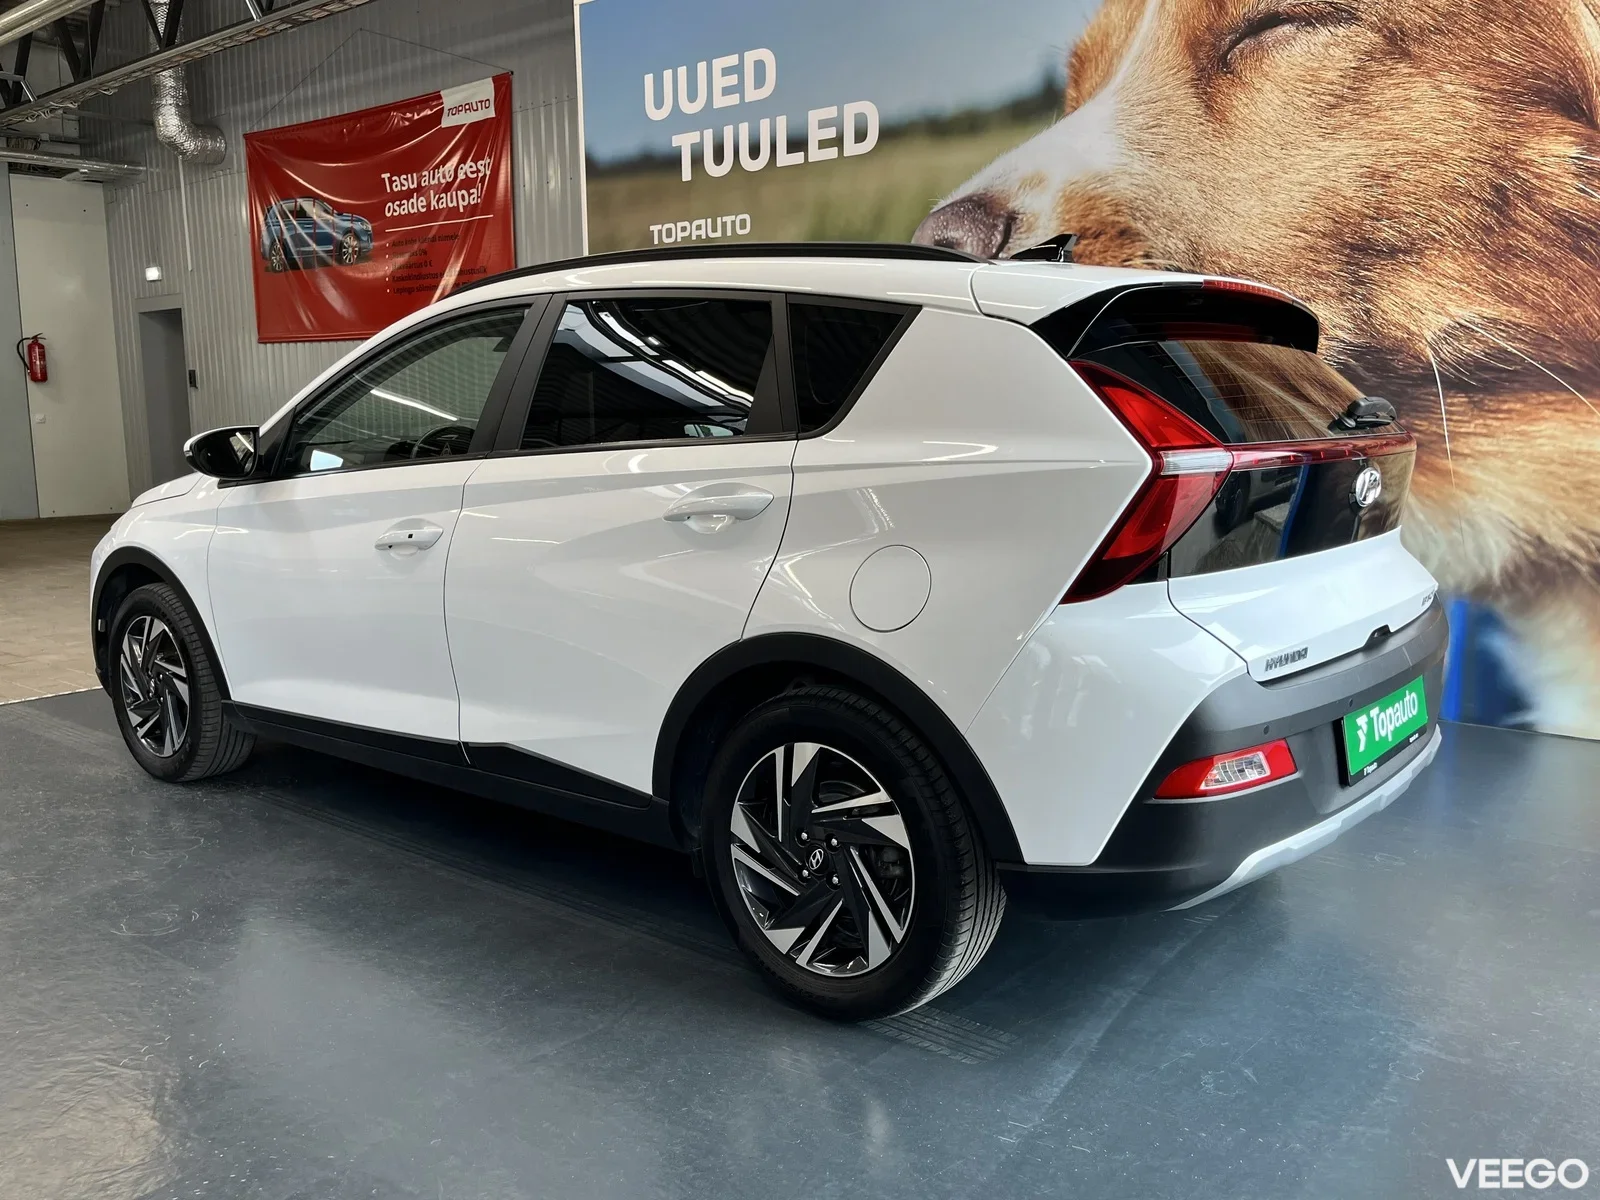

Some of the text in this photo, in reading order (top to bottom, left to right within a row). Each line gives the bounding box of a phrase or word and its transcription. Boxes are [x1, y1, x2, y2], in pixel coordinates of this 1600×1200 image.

[644, 48, 777, 121] UUED
[447, 98, 491, 117] TOPAUTO
[672, 100, 880, 182] TUULED
[381, 156, 491, 193] Tasu auto eest
[385, 183, 482, 217] osade kaupa!
[650, 213, 751, 245] TOPAUTO
[1370, 690, 1418, 742] Topauto
